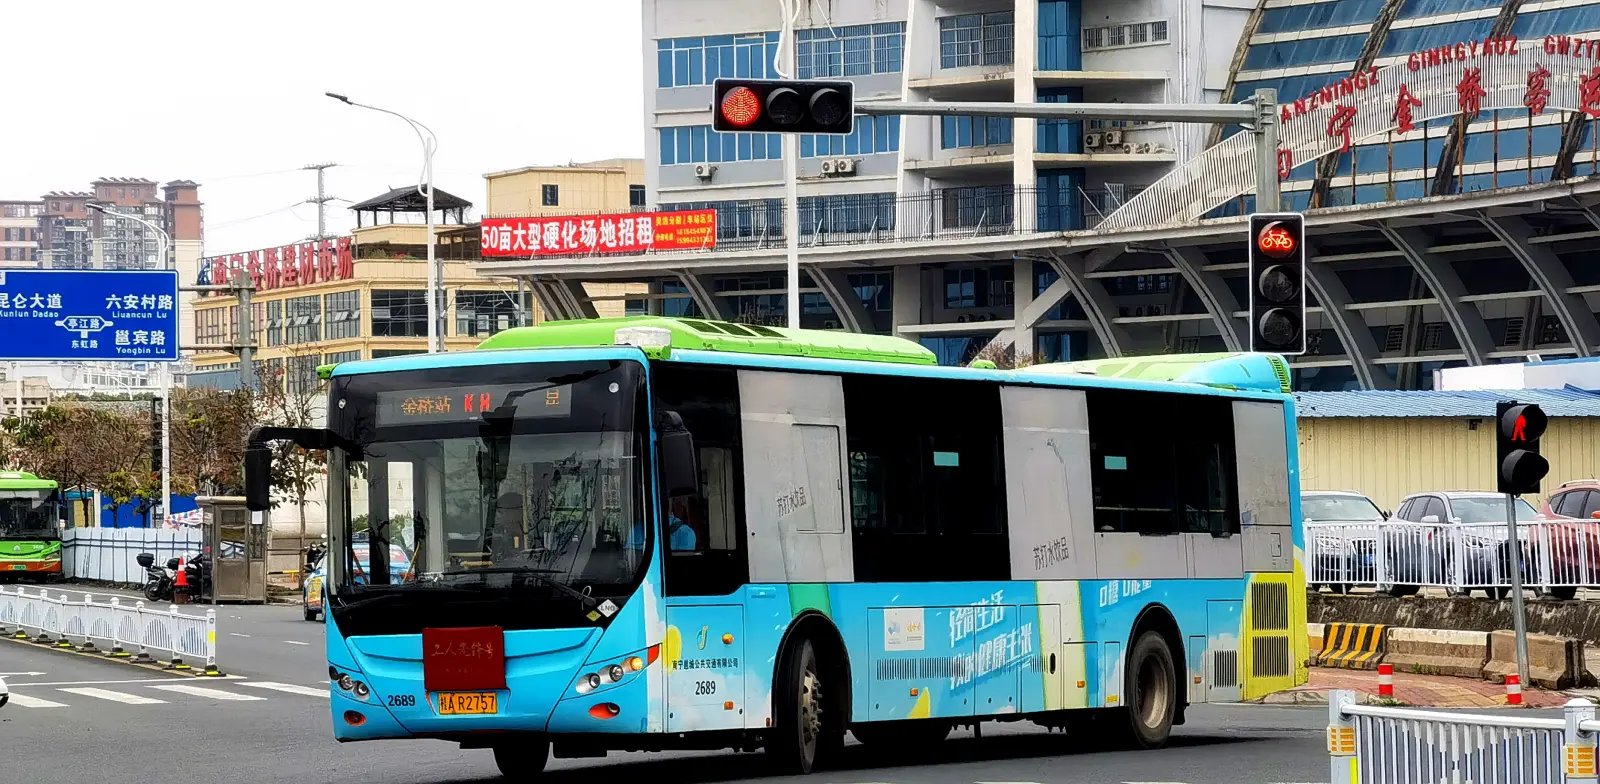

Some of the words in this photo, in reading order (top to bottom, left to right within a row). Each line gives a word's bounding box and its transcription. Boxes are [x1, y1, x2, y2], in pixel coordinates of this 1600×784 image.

[1281, 66, 1379, 124] ANZNINGZ
[1408, 36, 1518, 71] GINHGYAUZ
[1544, 35, 1600, 60] GWZY
[482, 217, 654, 252] 50亩大型硬化场地招租
[0, 293, 63, 309] 昆仑大道
[105, 294, 173, 310] 六安村路
[68, 319, 100, 329] 亭江路
[71, 340, 98, 349] 东虹路
[115, 330, 165, 346] 邕宾路
[116, 347, 151, 355] Yongbin
[1032, 536, 1069, 570] 苏打水饮品
[695, 680, 716, 695] 2689
[387, 694, 416, 708] 2689
